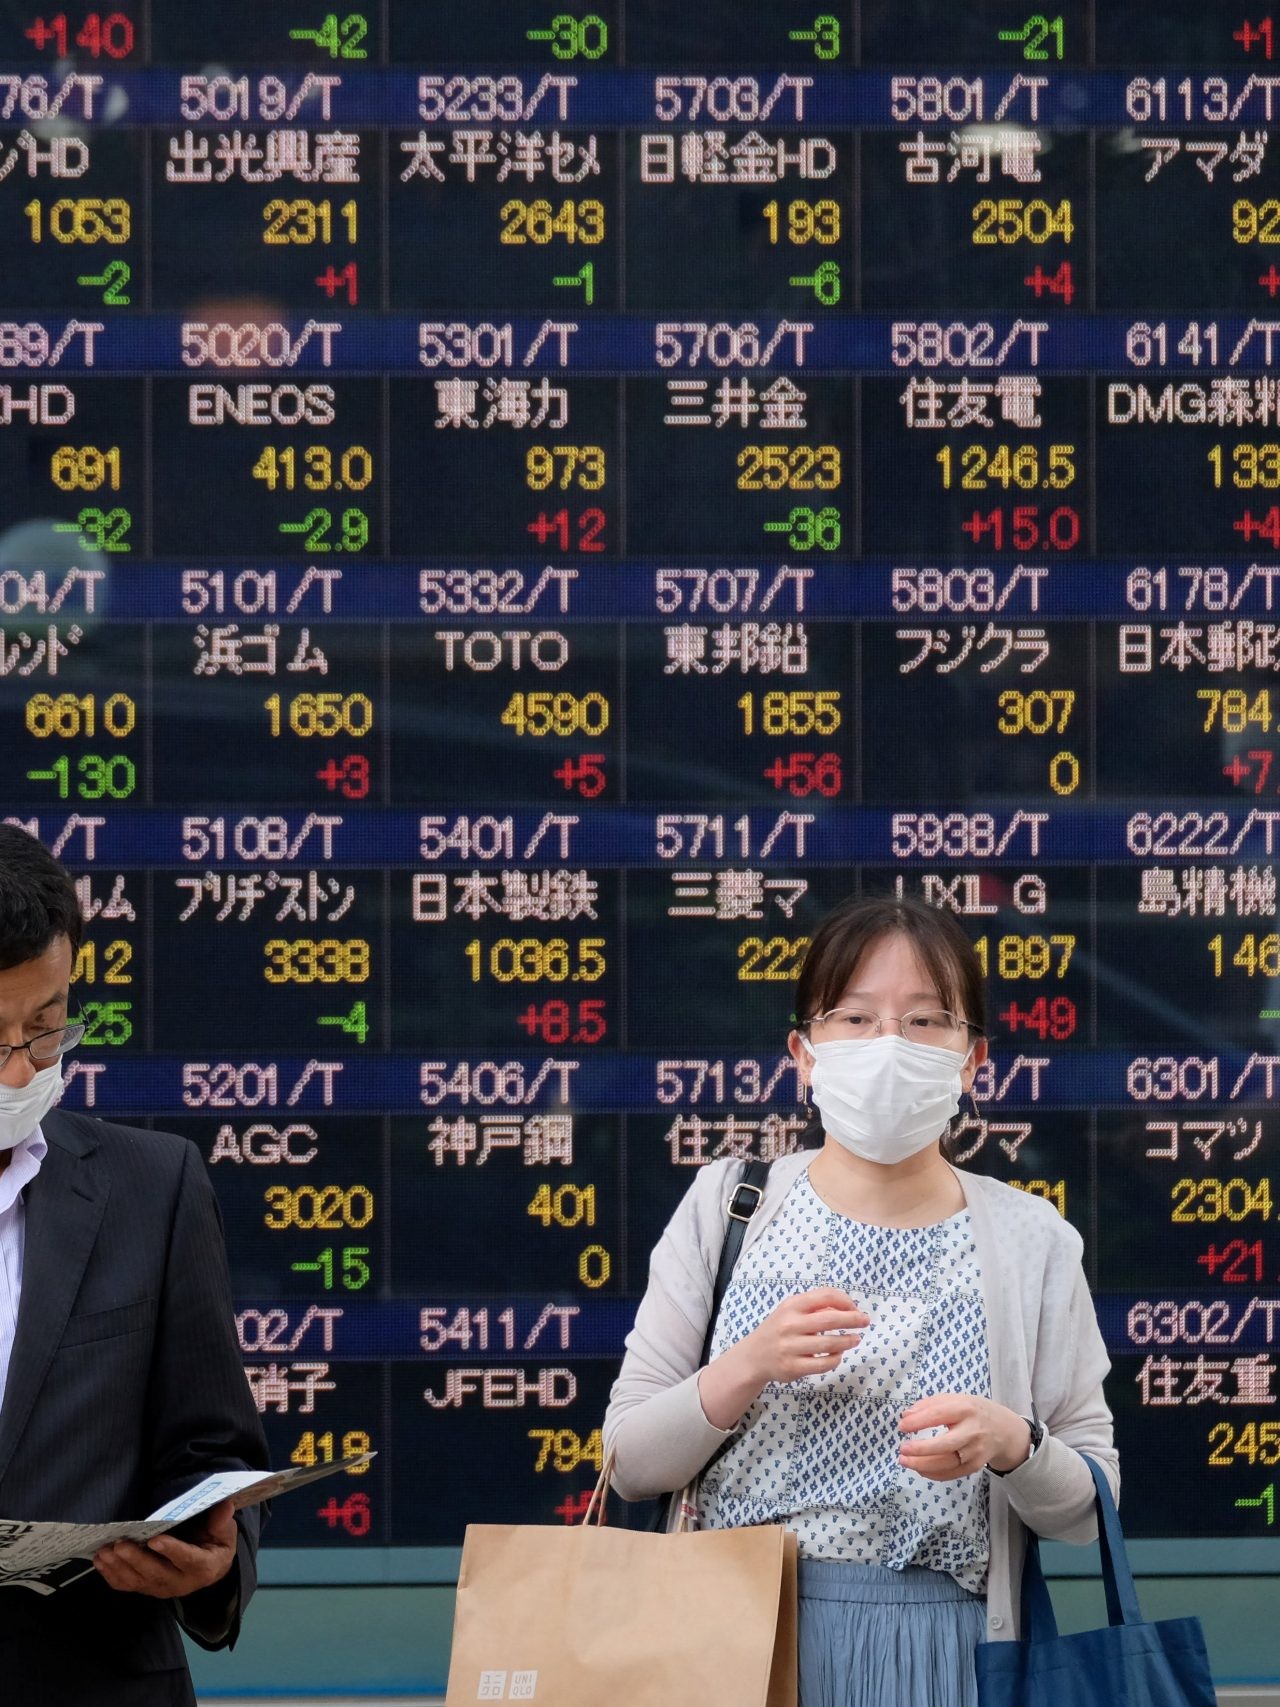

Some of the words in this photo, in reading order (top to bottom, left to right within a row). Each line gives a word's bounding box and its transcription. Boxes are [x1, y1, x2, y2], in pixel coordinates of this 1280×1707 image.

[27, 14, 133, 58] +140
[290, 15, 367, 58] -42
[527, 16, 607, 58] -30
[790, 16, 839, 58] -3
[999, 16, 1063, 59] -21
[181, 73, 341, 120] 5019/T
[419, 73, 577, 121] 5233/T
[656, 74, 813, 121] 5703/T
[892, 74, 1048, 121] 5801/T
[1126, 74, 1280, 120] 6113/T
[641, 131, 836, 182] 日軽金HD
[899, 128, 1042, 182] 古河電
[25, 199, 130, 243] 1053
[263, 200, 356, 244] 2311
[501, 200, 604, 244] 2643
[763, 200, 840, 244] 193
[973, 200, 1074, 243] 2504
[79, 261, 130, 304] -2
[317, 264, 357, 304] +1
[553, 263, 593, 304] -1
[790, 262, 840, 305] -6
[1025, 263, 1073, 304] +4
[182, 320, 342, 367] 5020/T
[656, 320, 814, 367] 5706/T
[892, 319, 1048, 366] 5802/T
[190, 385, 335, 424] ENEOS
[664, 377, 807, 428] 三井金
[900, 376, 1041, 427] 住友電
[52, 447, 120, 490] 691
[253, 446, 372, 490] 413.0
[527, 446, 605, 490] 973
[738, 446, 840, 489] 2523
[937, 445, 1074, 489] 1246.5
[53, 509, 131, 551] -32
[280, 509, 368, 551] -2.9
[529, 509, 605, 551] +12
[764, 508, 840, 550] -36
[963, 507, 1079, 549] +15.0
[182, 567, 342, 613] 5101/T
[420, 566, 578, 613] 5332/T
[656, 565, 814, 612] 5707/T
[892, 565, 1048, 611] 5803/T
[1127, 565, 1280, 610] 6178/T
[435, 631, 568, 671] TOTO
[26, 694, 135, 737] 6610
[265, 693, 372, 736] 1650
[501, 693, 609, 736] 4590
[738, 692, 841, 735] 1855
[999, 691, 1075, 734] 307
[28, 756, 135, 798] -130
[319, 756, 368, 798] +3
[556, 754, 605, 797] +5
[765, 753, 841, 796] +56
[183, 813, 343, 860] 5108/T
[892, 810, 1049, 857] 5938/T
[1127, 808, 1280, 856] 6222/T
[413, 870, 598, 921] 日本製鉄
[265, 940, 369, 982] 3338
[465, 939, 605, 982] 1036.5
[320, 1002, 369, 1043] -4
[520, 1000, 605, 1043] +8.5
[1000, 997, 1077, 1041] +49
[421, 1058, 579, 1105] 5406/T
[210, 1125, 317, 1163] AGC
[428, 1114, 573, 1165] 神戸鋼
[1146, 1118, 1262, 1160] コマツ
[265, 1186, 373, 1228] 3020
[528, 1184, 595, 1226] 401
[293, 1248, 369, 1289] -15
[1126, 1298, 1280, 1344] 6302/T
[423, 1369, 577, 1408] JFEHD
[1136, 1354, 1277, 1404] 住友重
[317, 1493, 370, 1536] +6
